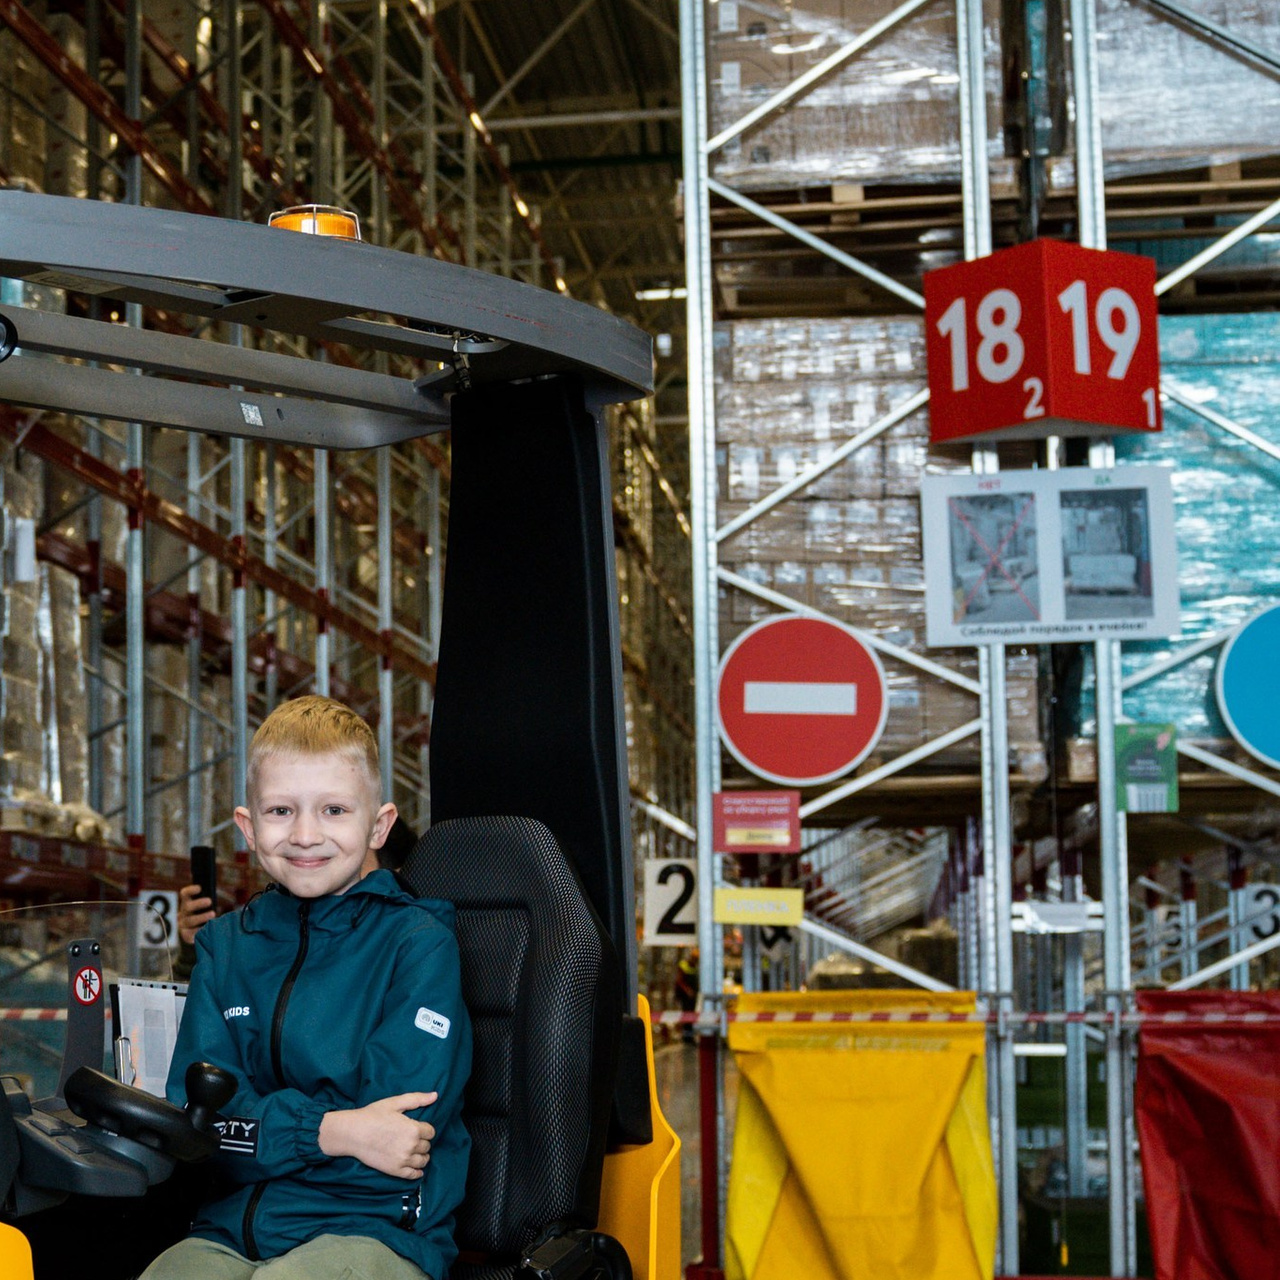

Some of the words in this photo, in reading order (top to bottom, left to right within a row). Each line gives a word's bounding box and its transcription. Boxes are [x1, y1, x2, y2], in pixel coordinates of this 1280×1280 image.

[936, 288, 1025, 392] 18
[1057, 279, 1141, 381] 19
[1023, 377, 1045, 419] 2
[1142, 387, 1156, 428] 1
[144, 895, 172, 944] 3
[656, 864, 696, 934] 2
[1252, 889, 1280, 939] 3
[228, 1006, 250, 1018] KIDS
